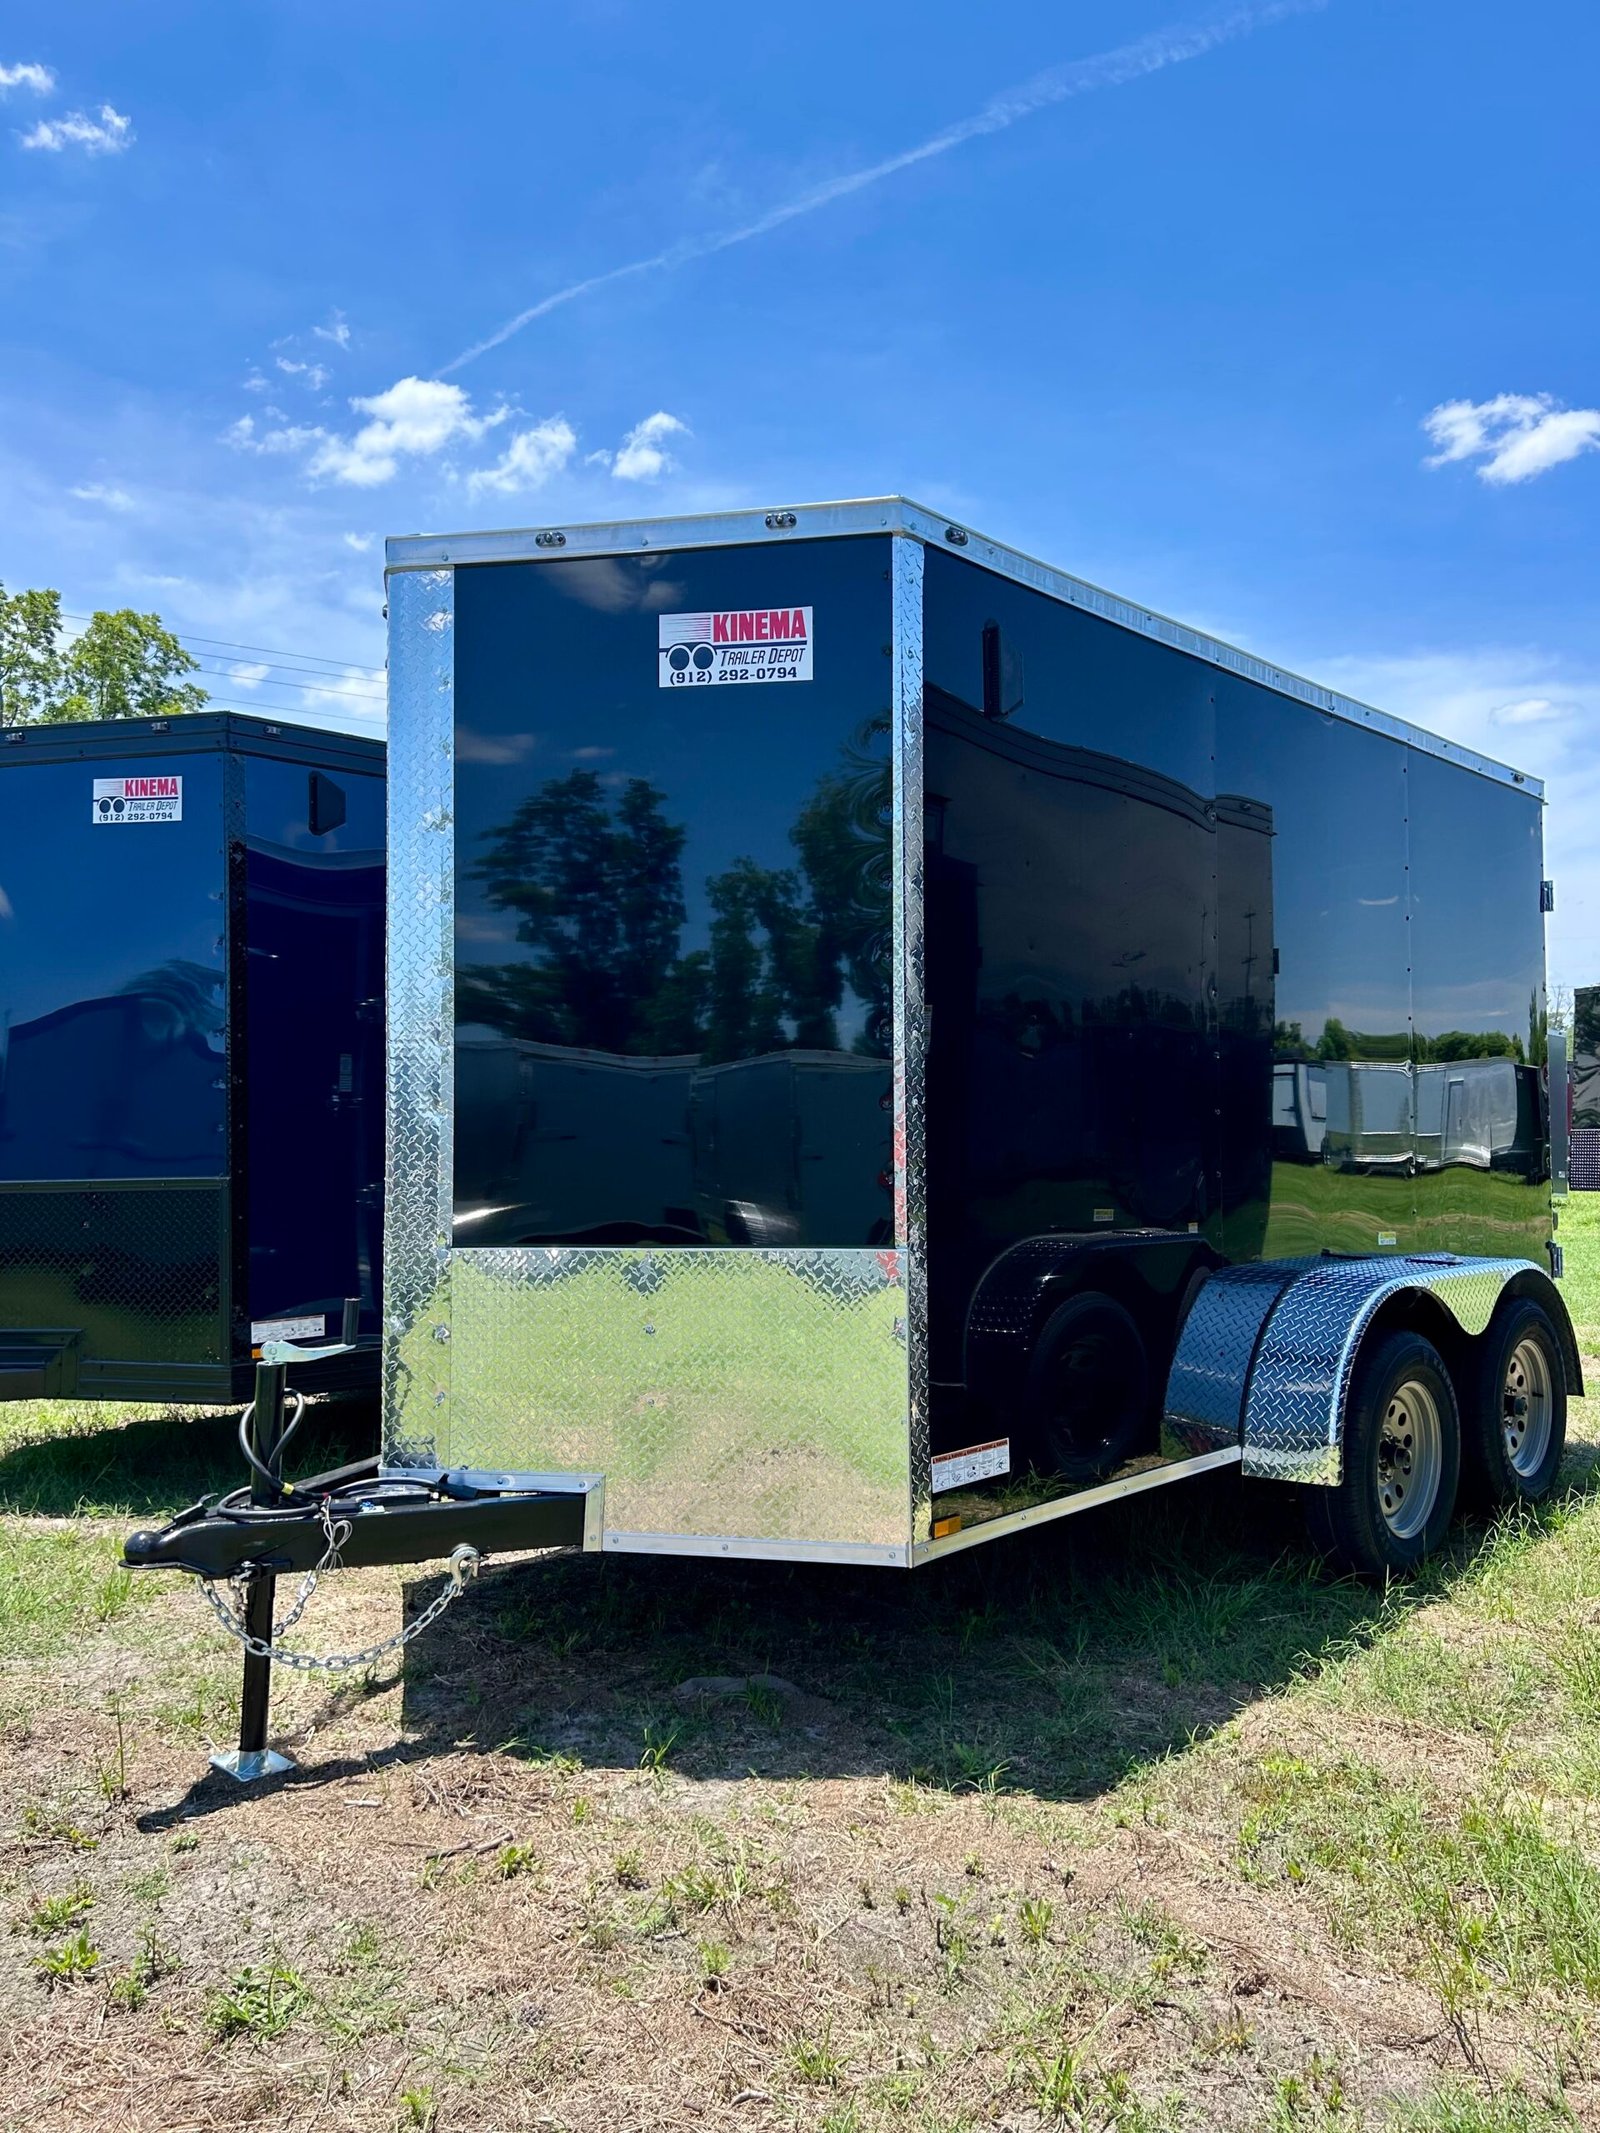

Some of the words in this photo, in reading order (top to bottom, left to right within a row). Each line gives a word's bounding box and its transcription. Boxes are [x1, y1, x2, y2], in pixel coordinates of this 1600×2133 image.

[713, 609, 806, 643] KINEMA
[720, 649, 766, 667] TRAILER
[768, 647, 805, 665] DEPOT
[669, 670, 712, 685] (912)
[718, 667, 797, 681] 292-0794
[125, 778, 178, 797] KINEMA
[129, 801, 155, 812] TRAILER
[156, 800, 178, 811] DEPOT
[99, 813, 124, 822] (912)
[128, 812, 173, 821] 292-0794
